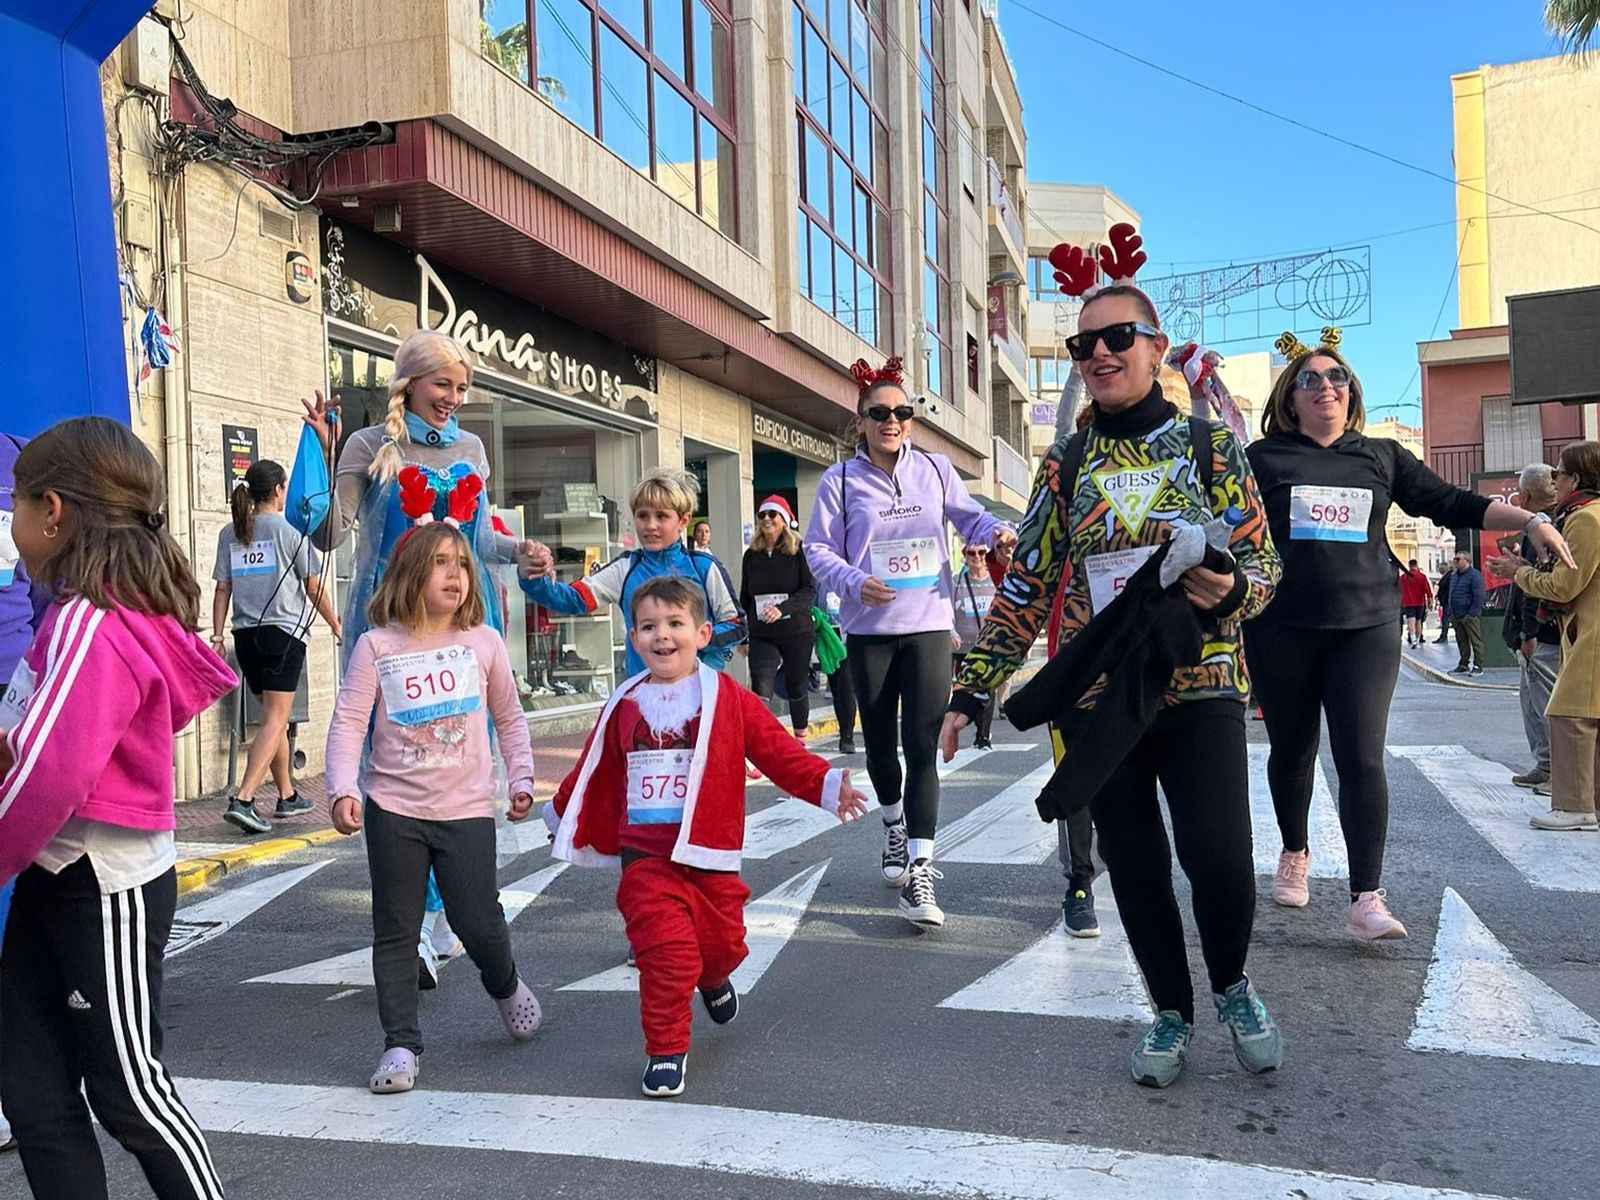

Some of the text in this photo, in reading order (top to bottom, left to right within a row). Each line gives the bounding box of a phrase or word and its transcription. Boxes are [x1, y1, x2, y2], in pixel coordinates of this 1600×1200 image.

[415, 253, 622, 402] Dana SHOES
[1275, 326, 1342, 355] 20 25
[754, 414, 789, 444] EDIFICIO
[1104, 470, 1161, 491] GUESS
[879, 505, 922, 518] SIROKO
[1311, 504, 1350, 523] 508
[242, 552, 264, 565] 102
[888, 554, 920, 573] 531
[406, 669, 456, 700] 510
[641, 774, 688, 800] 575
[711, 991, 732, 1007] PUMA
[652, 1062, 678, 1072] PUMA
